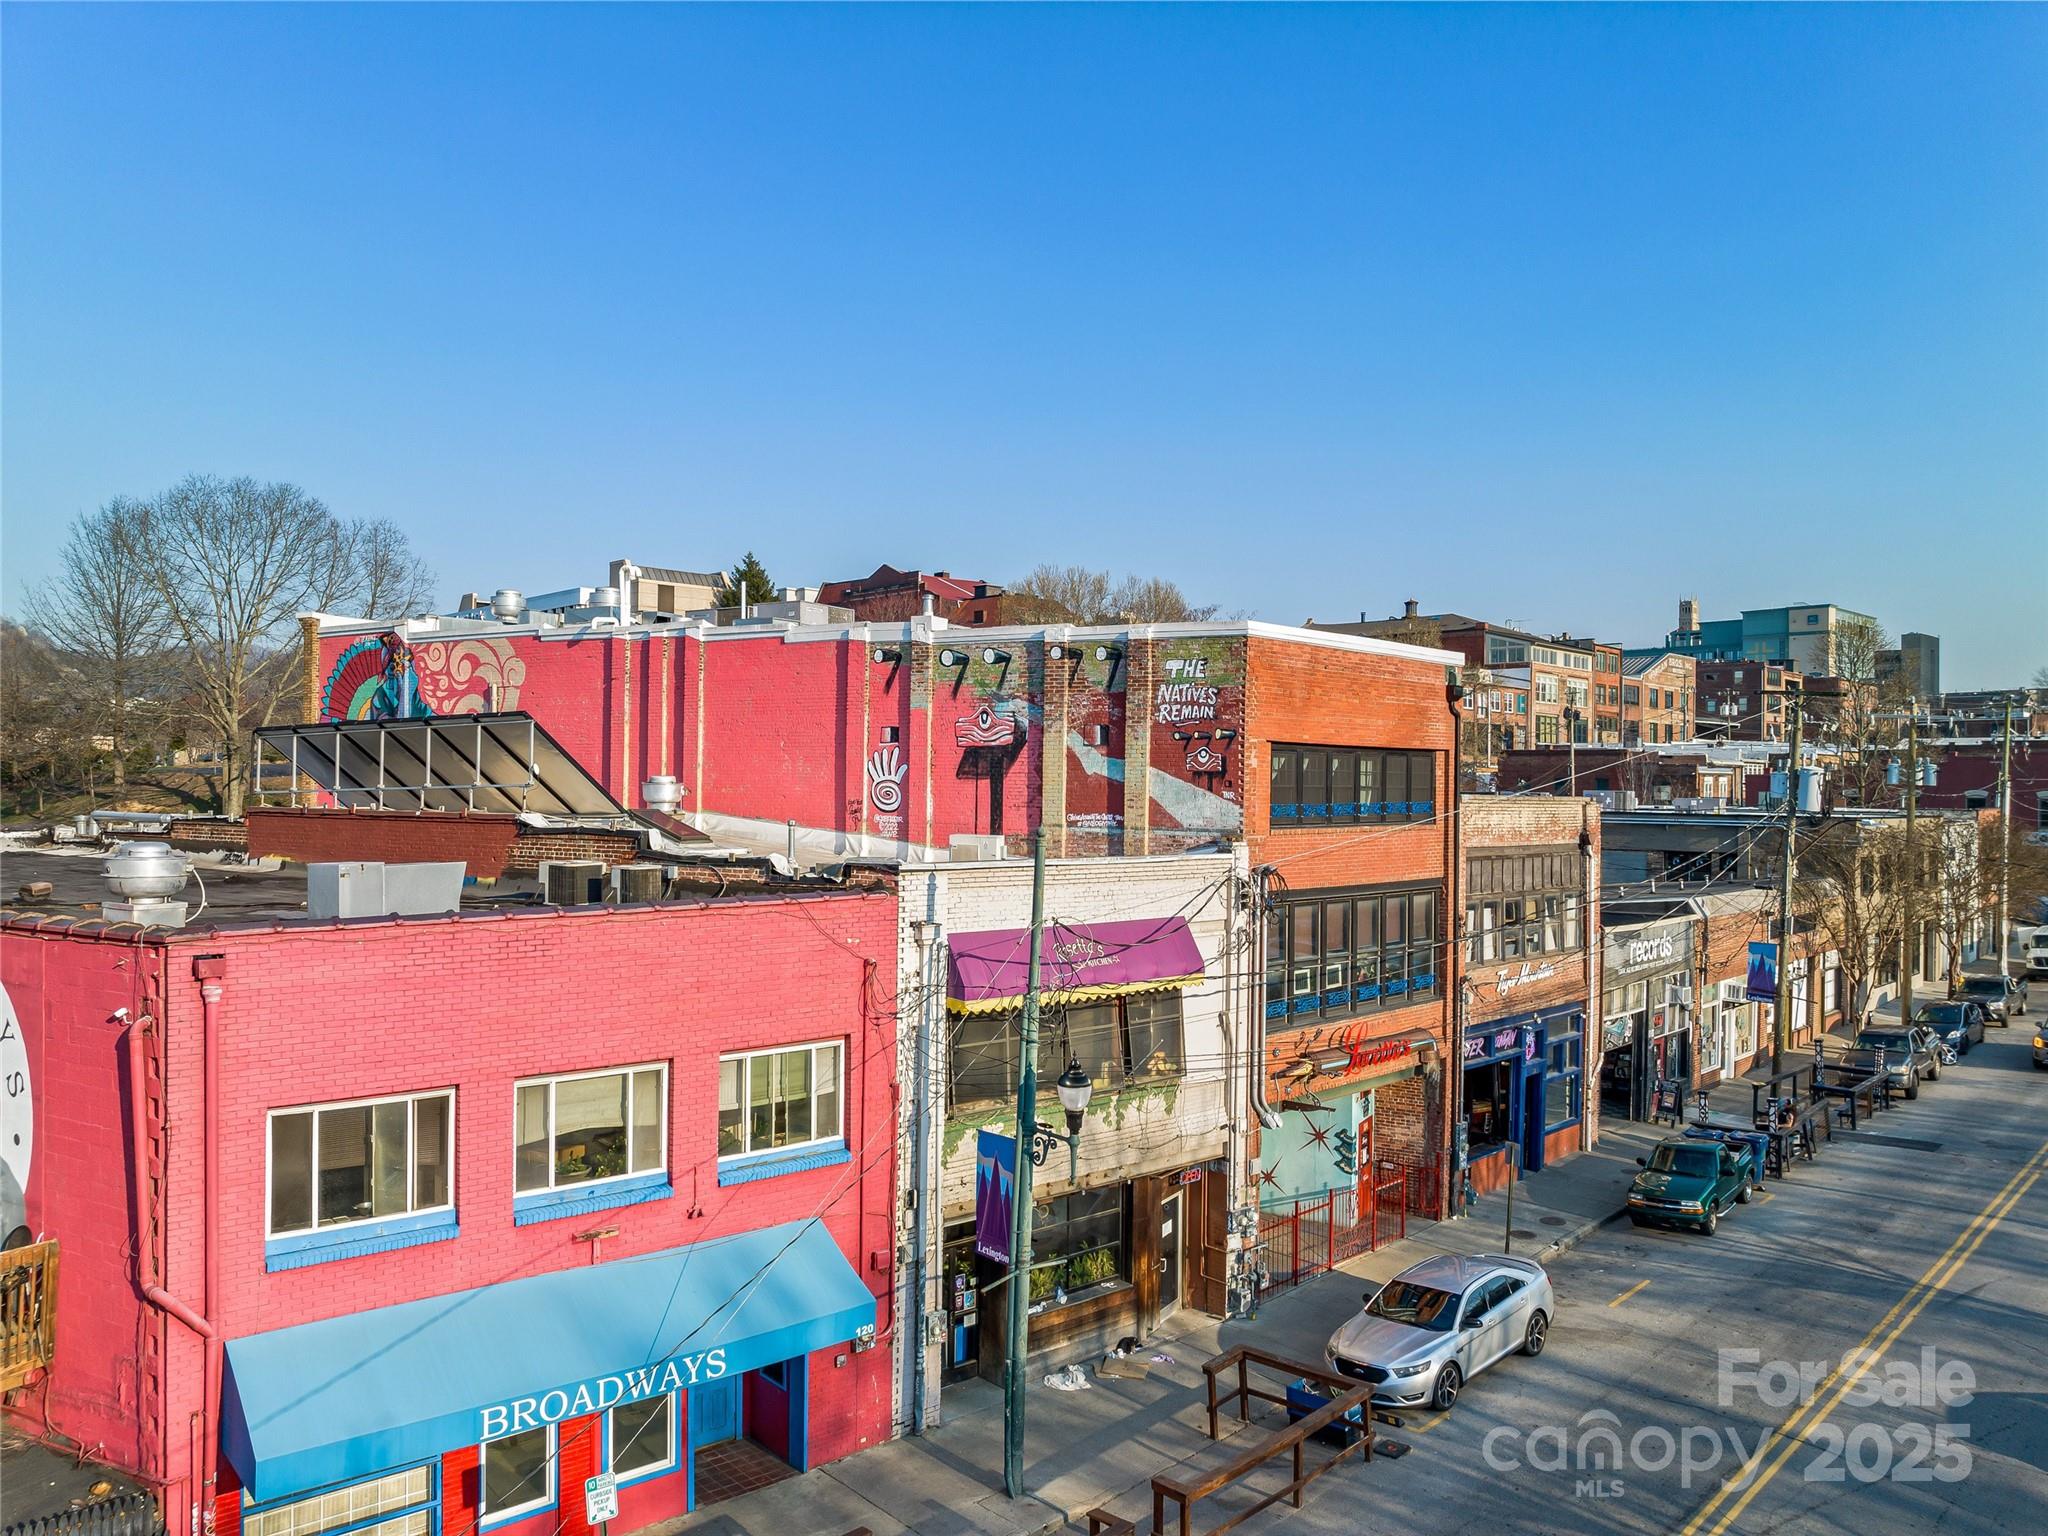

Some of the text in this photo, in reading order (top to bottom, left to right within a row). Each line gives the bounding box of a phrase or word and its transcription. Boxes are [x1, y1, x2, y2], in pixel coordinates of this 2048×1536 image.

[1165, 658, 1207, 678] THE
[1158, 682, 1218, 704] NATIVES
[1157, 703, 1214, 723] REMAIN
[1630, 930, 1673, 964] records
[977, 1241, 1010, 1264] Lexington
[855, 1323, 874, 1337] 120
[479, 1348, 727, 1441] BROADWAYS
[590, 1488, 612, 1501] CURBSIDE
[593, 1496, 611, 1507] PICKUP
[597, 1504, 609, 1514] ONLY
